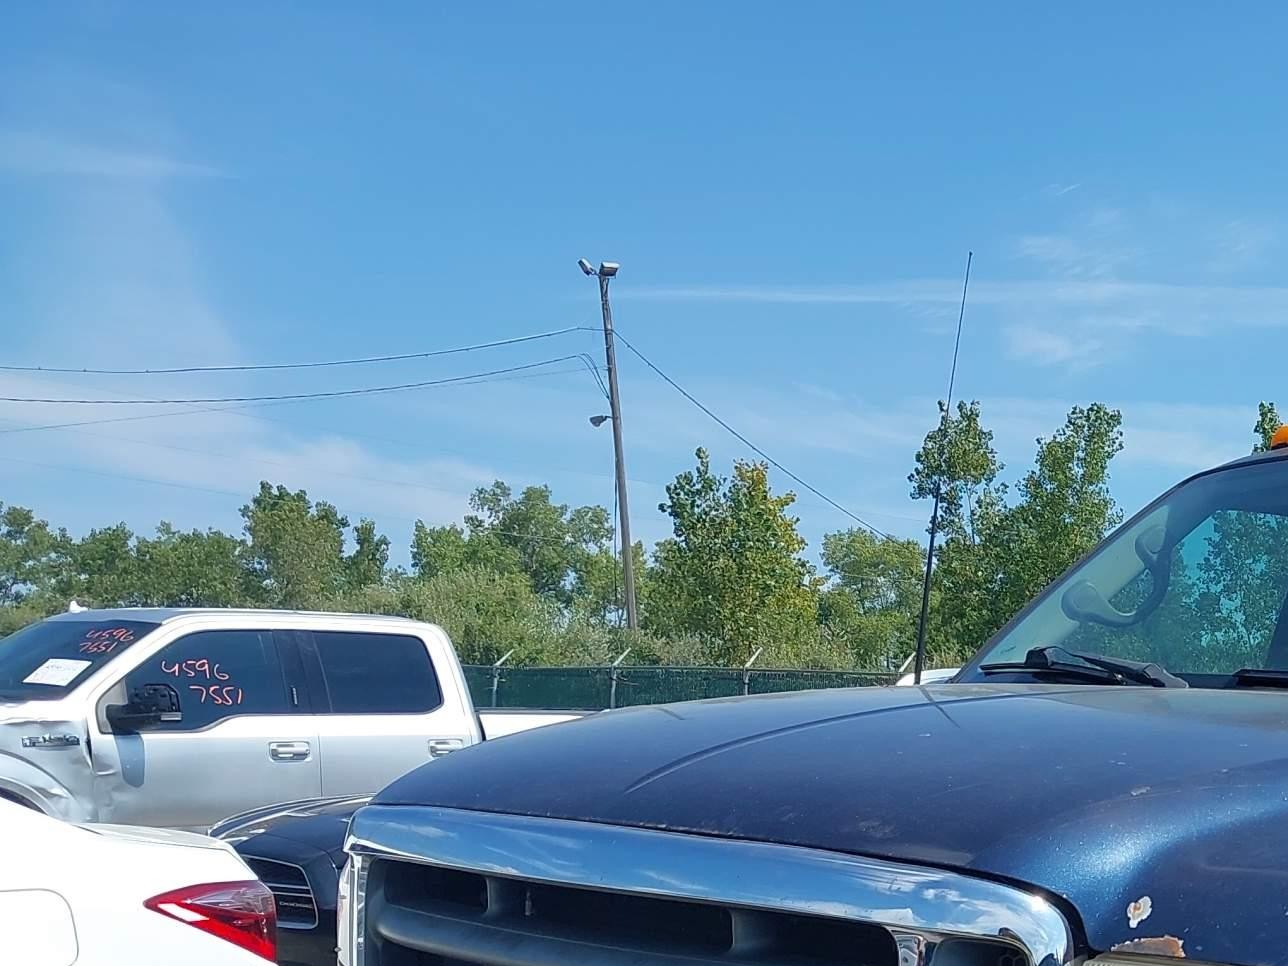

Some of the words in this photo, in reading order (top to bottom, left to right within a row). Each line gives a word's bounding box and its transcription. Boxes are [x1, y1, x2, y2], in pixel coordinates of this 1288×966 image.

[86, 628, 134, 642] 4596
[80, 641, 117, 653] 7551
[161, 659, 229, 680] 4596
[189, 685, 243, 706] 7551
